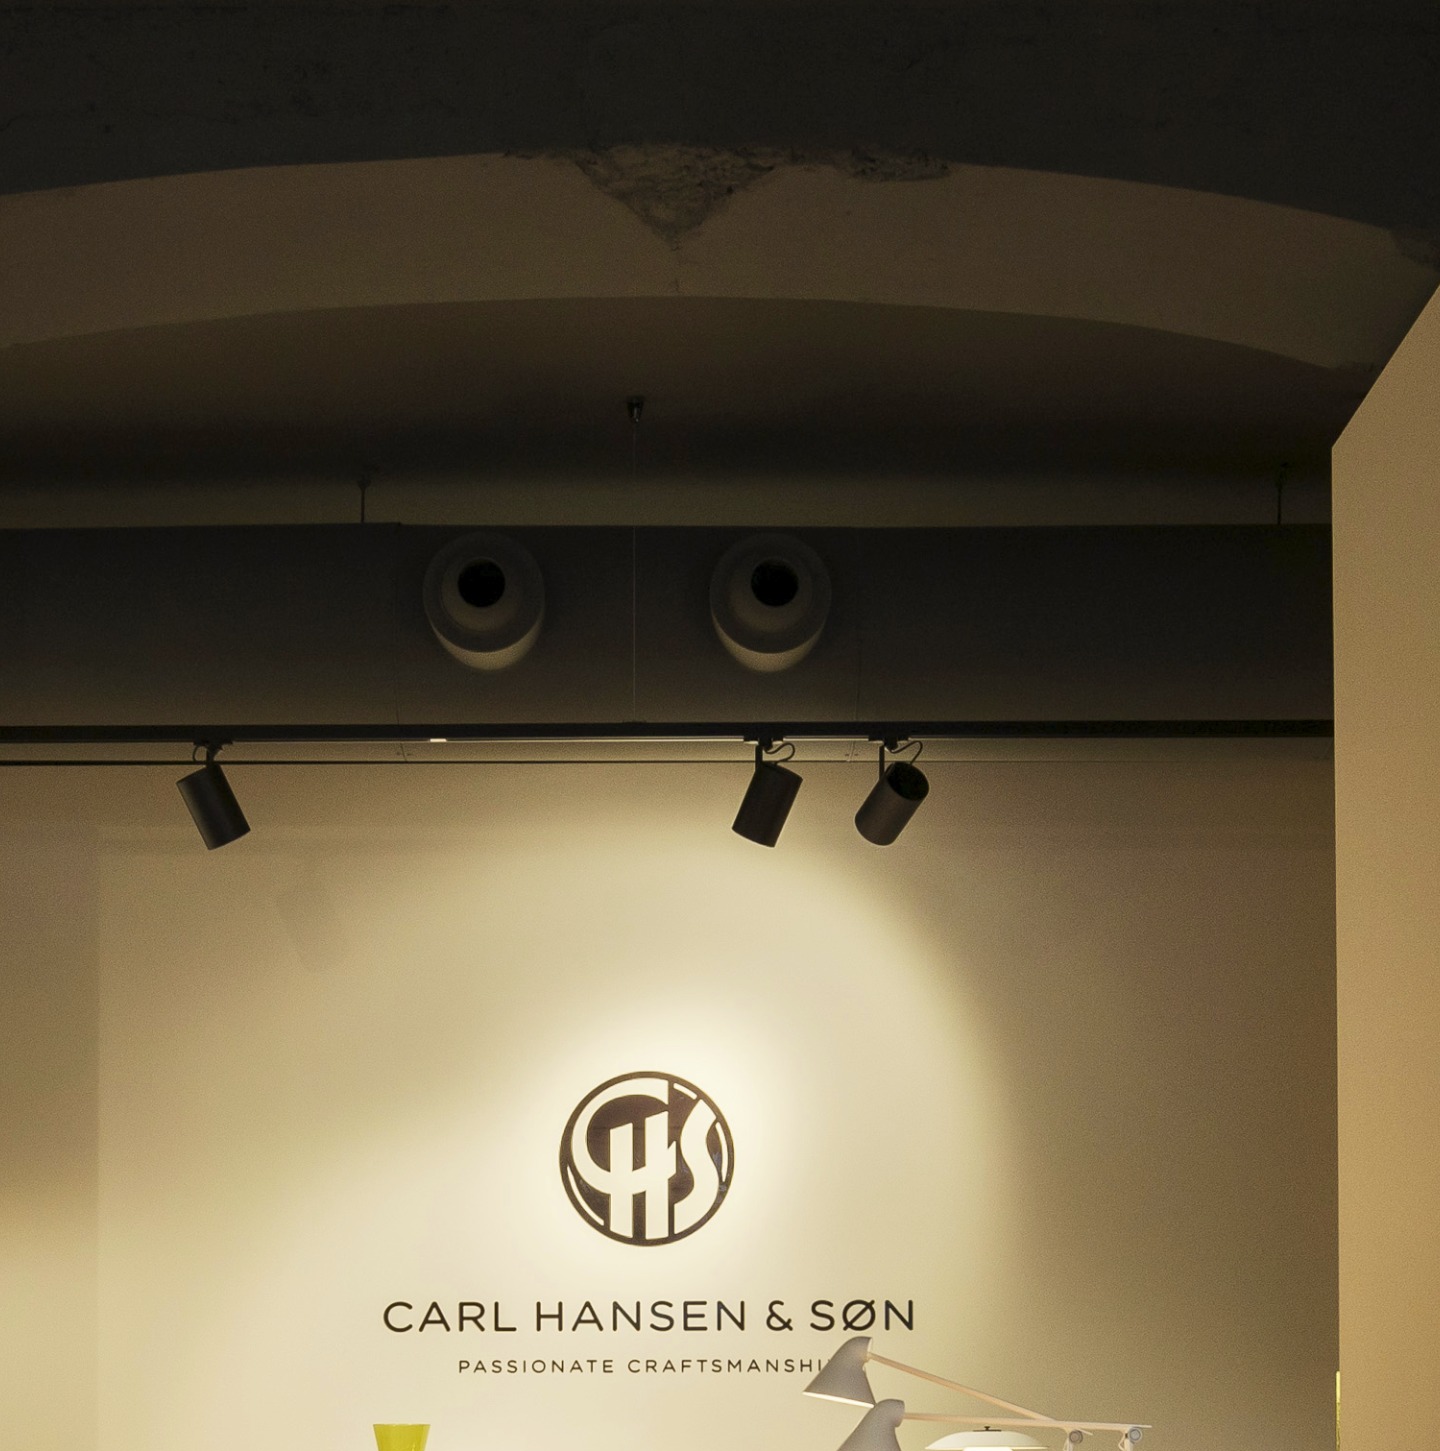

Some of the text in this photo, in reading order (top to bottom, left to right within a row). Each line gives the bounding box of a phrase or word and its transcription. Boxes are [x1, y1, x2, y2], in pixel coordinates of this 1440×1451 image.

[383, 1299, 914, 1333] CARL HANSEN & SØN
[458, 1359, 830, 1374] PASSIONATE CRAFTSMANSHI
